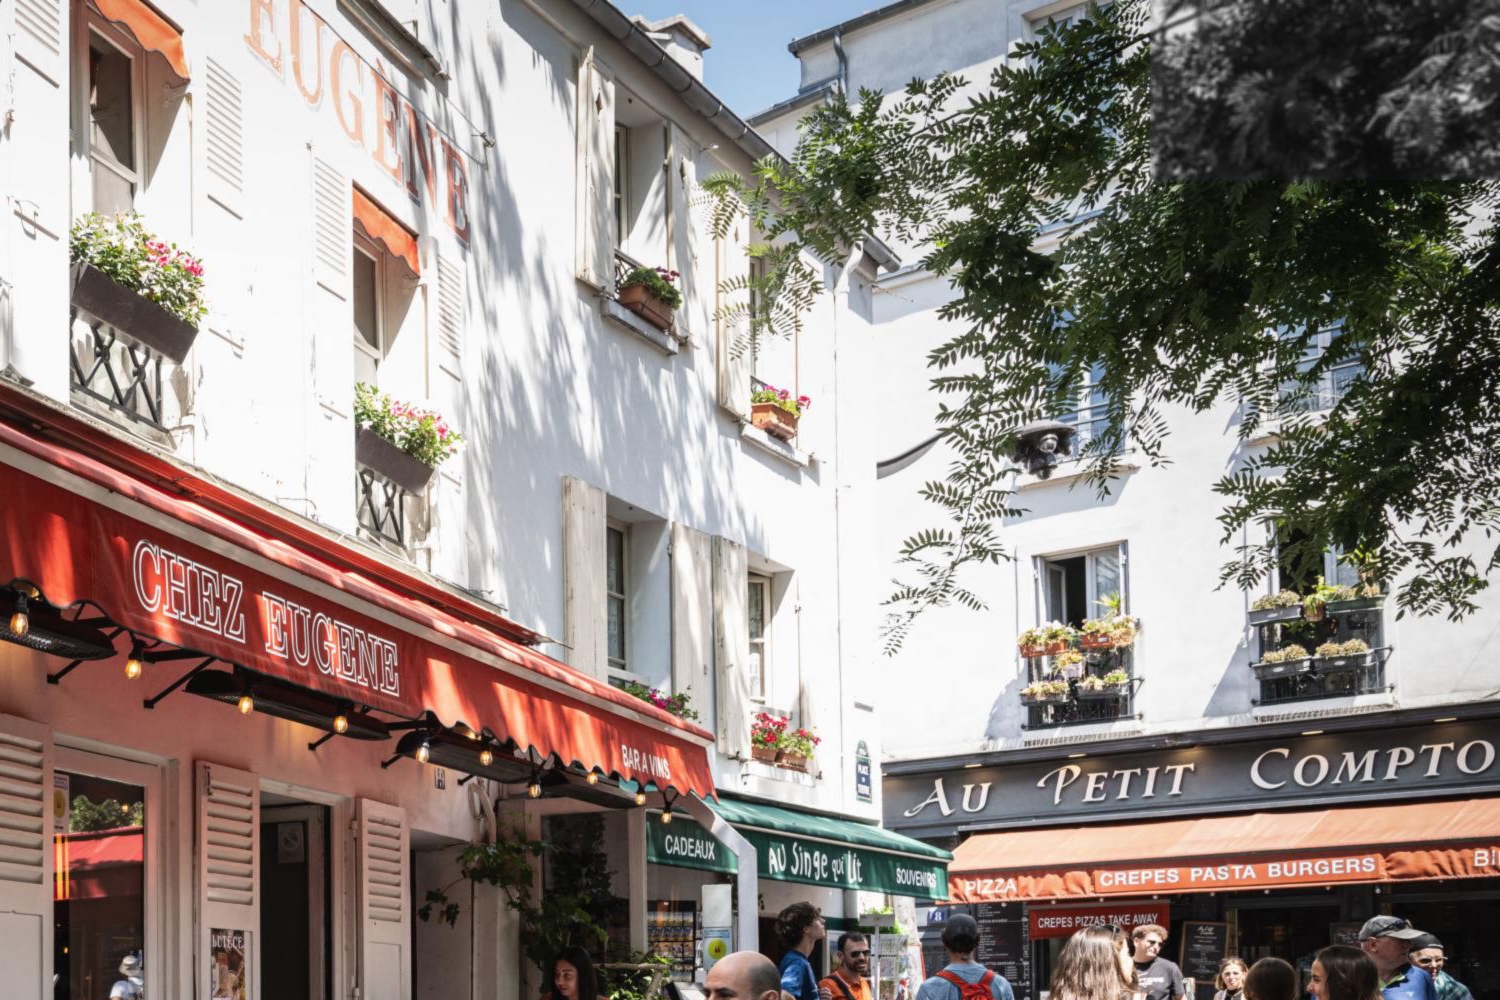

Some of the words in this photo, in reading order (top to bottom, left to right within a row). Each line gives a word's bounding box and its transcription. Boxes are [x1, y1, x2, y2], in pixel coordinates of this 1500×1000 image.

[133, 539, 246, 644] CHEZ
[262, 591, 400, 697] EUGENE
[621, 744, 641, 772] BAR
[642, 752, 649, 774] A
[649, 754, 671, 781] VINS
[904, 777, 993, 818] AU
[1036, 762, 1195, 806] PETIT
[665, 834, 716, 861] CADEAUX
[1474, 846, 1500, 867] BI
[768, 846, 787, 875] AU
[790, 842, 828, 880] Singe
[832, 855, 846, 883] qui
[847, 850, 863, 885] Lit
[896, 866, 937, 889] SOUVENIRS
[1100, 868, 1180, 887] CREPES
[1190, 863, 1256, 883] PASTA
[1267, 857, 1377, 878] BURGERS
[965, 878, 1018, 895] PIZZA
[1038, 915, 1073, 929] CREPES
[1075, 914, 1106, 928] PIZZAS
[1107, 914, 1131, 926] TAKE
[1132, 912, 1158, 925] AWAY
